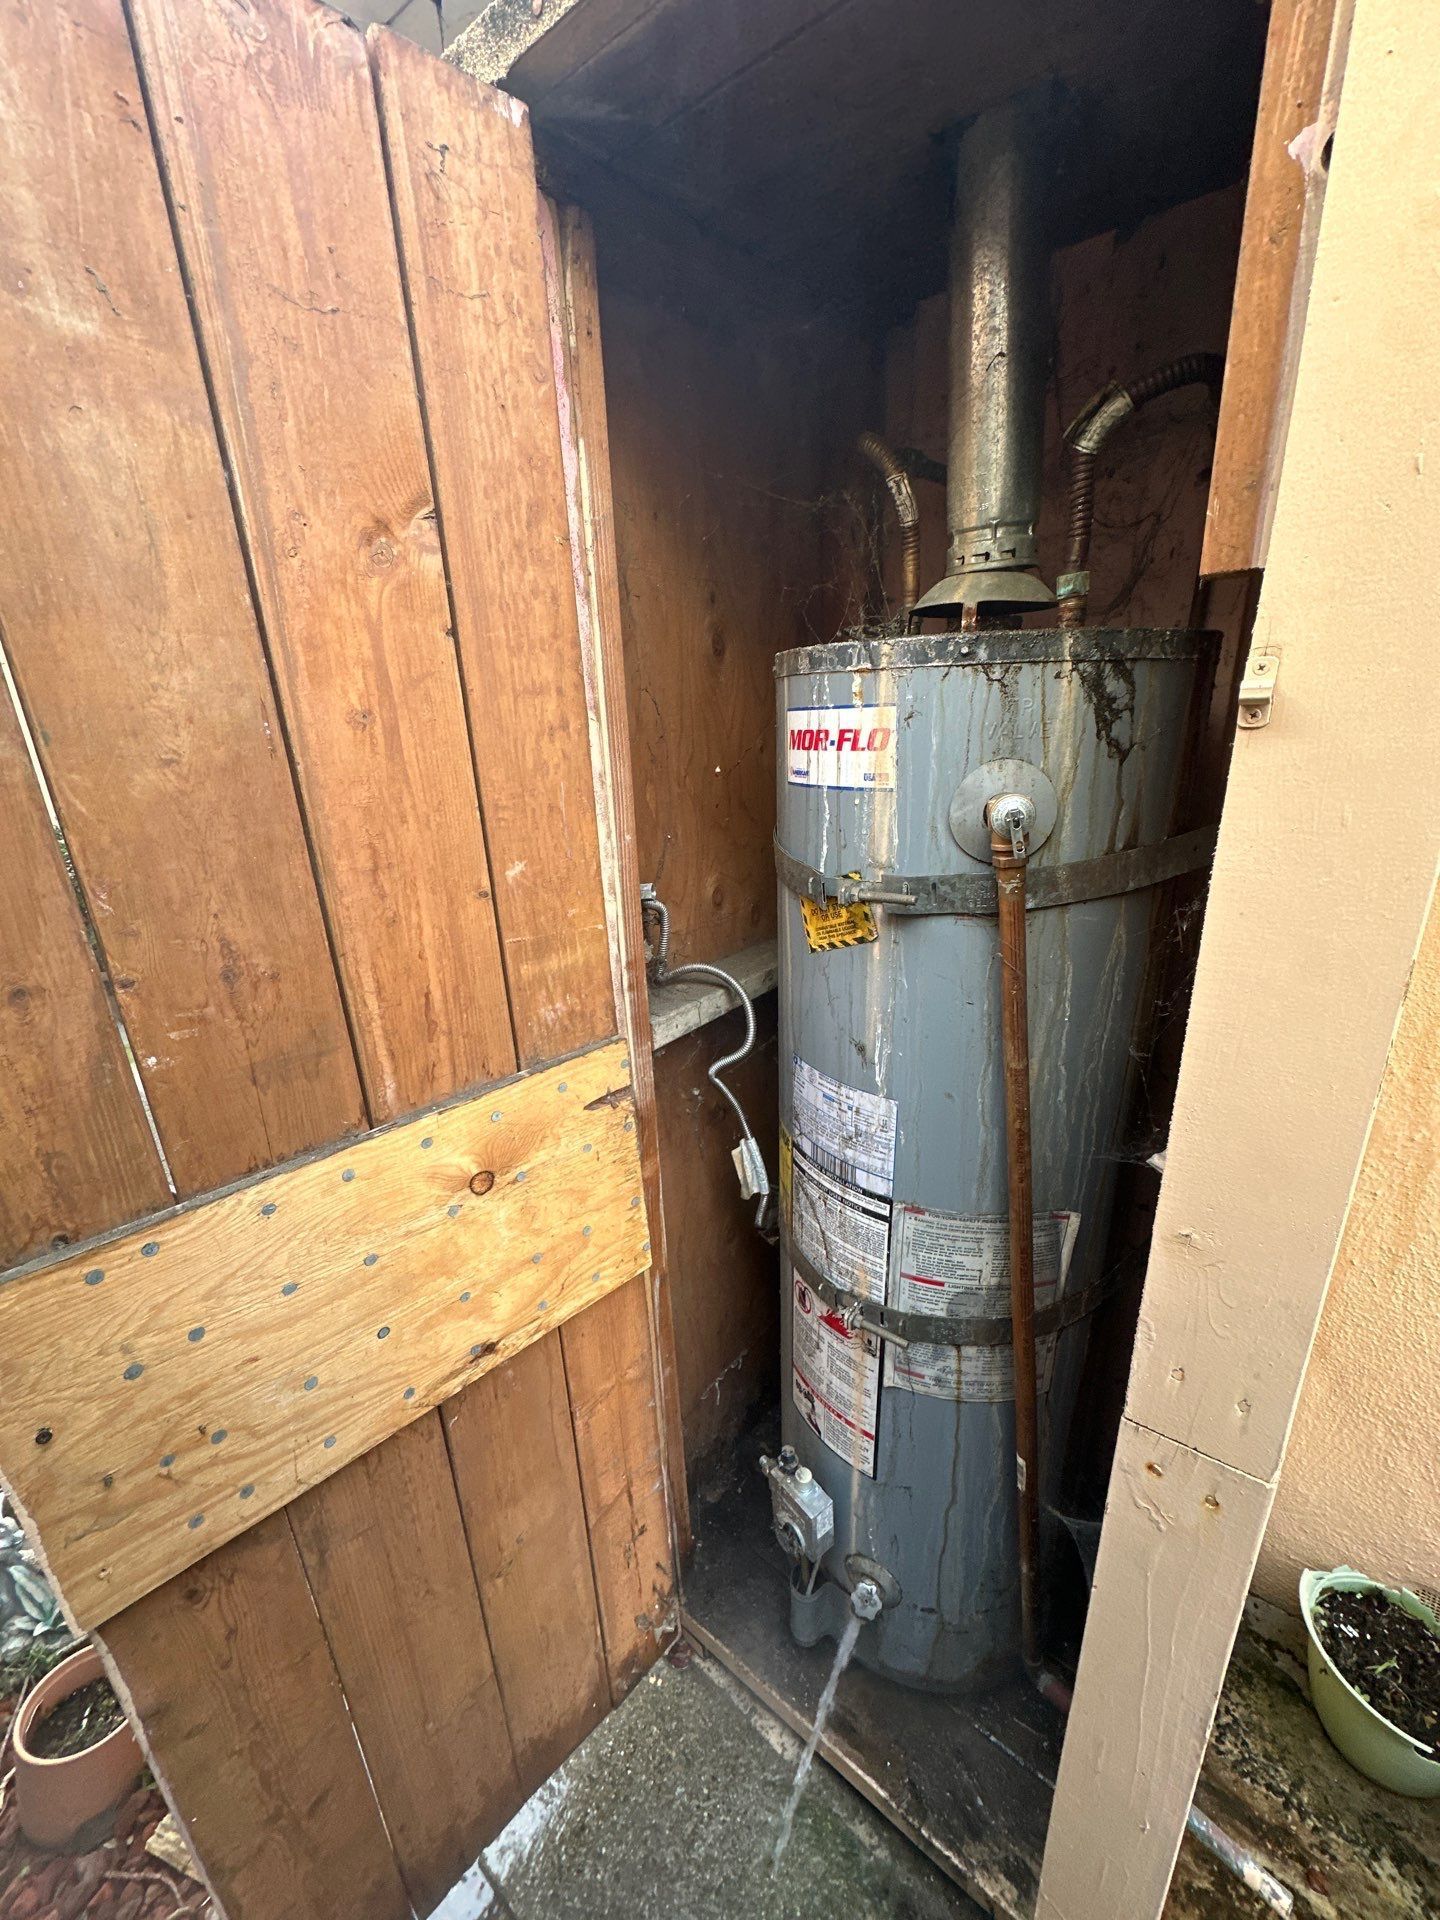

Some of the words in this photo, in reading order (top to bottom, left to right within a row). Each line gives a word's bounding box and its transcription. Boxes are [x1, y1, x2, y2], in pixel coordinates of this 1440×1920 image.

[988, 720, 1053, 740] VALVE
[789, 728, 891, 752] MOR-FLO
[863, 772, 876, 782] USA
[810, 908, 819, 916] DO
[822, 914, 830, 922] OR
[831, 911, 842, 919] USE
[826, 1170, 863, 1194] INSTALLATION
[842, 1198, 863, 1212] NOTICE
